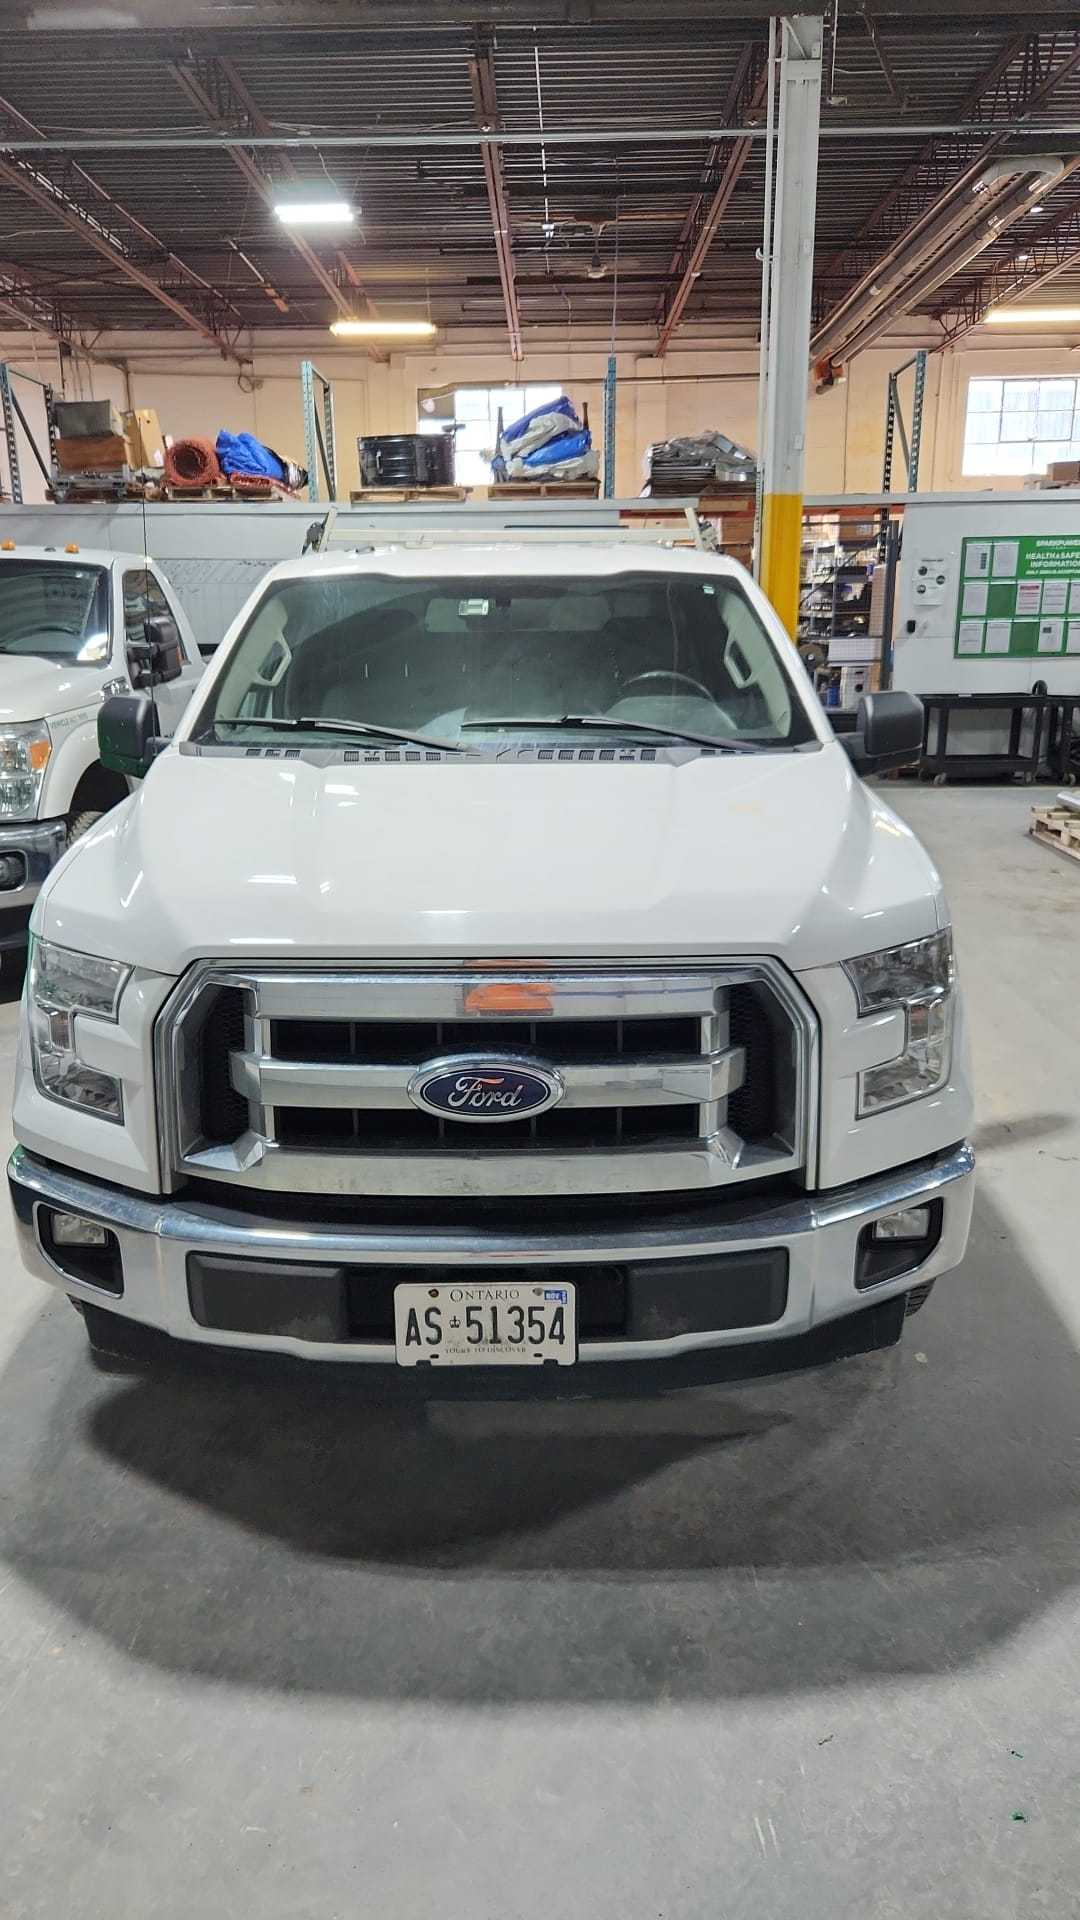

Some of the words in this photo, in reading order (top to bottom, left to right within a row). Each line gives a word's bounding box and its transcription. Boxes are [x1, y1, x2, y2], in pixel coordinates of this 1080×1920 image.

[447, 1076, 524, 1107] Ford
[450, 1288, 520, 1302] ONTARIO
[405, 1306, 443, 1346] AS
[465, 1305, 566, 1345] 51354
